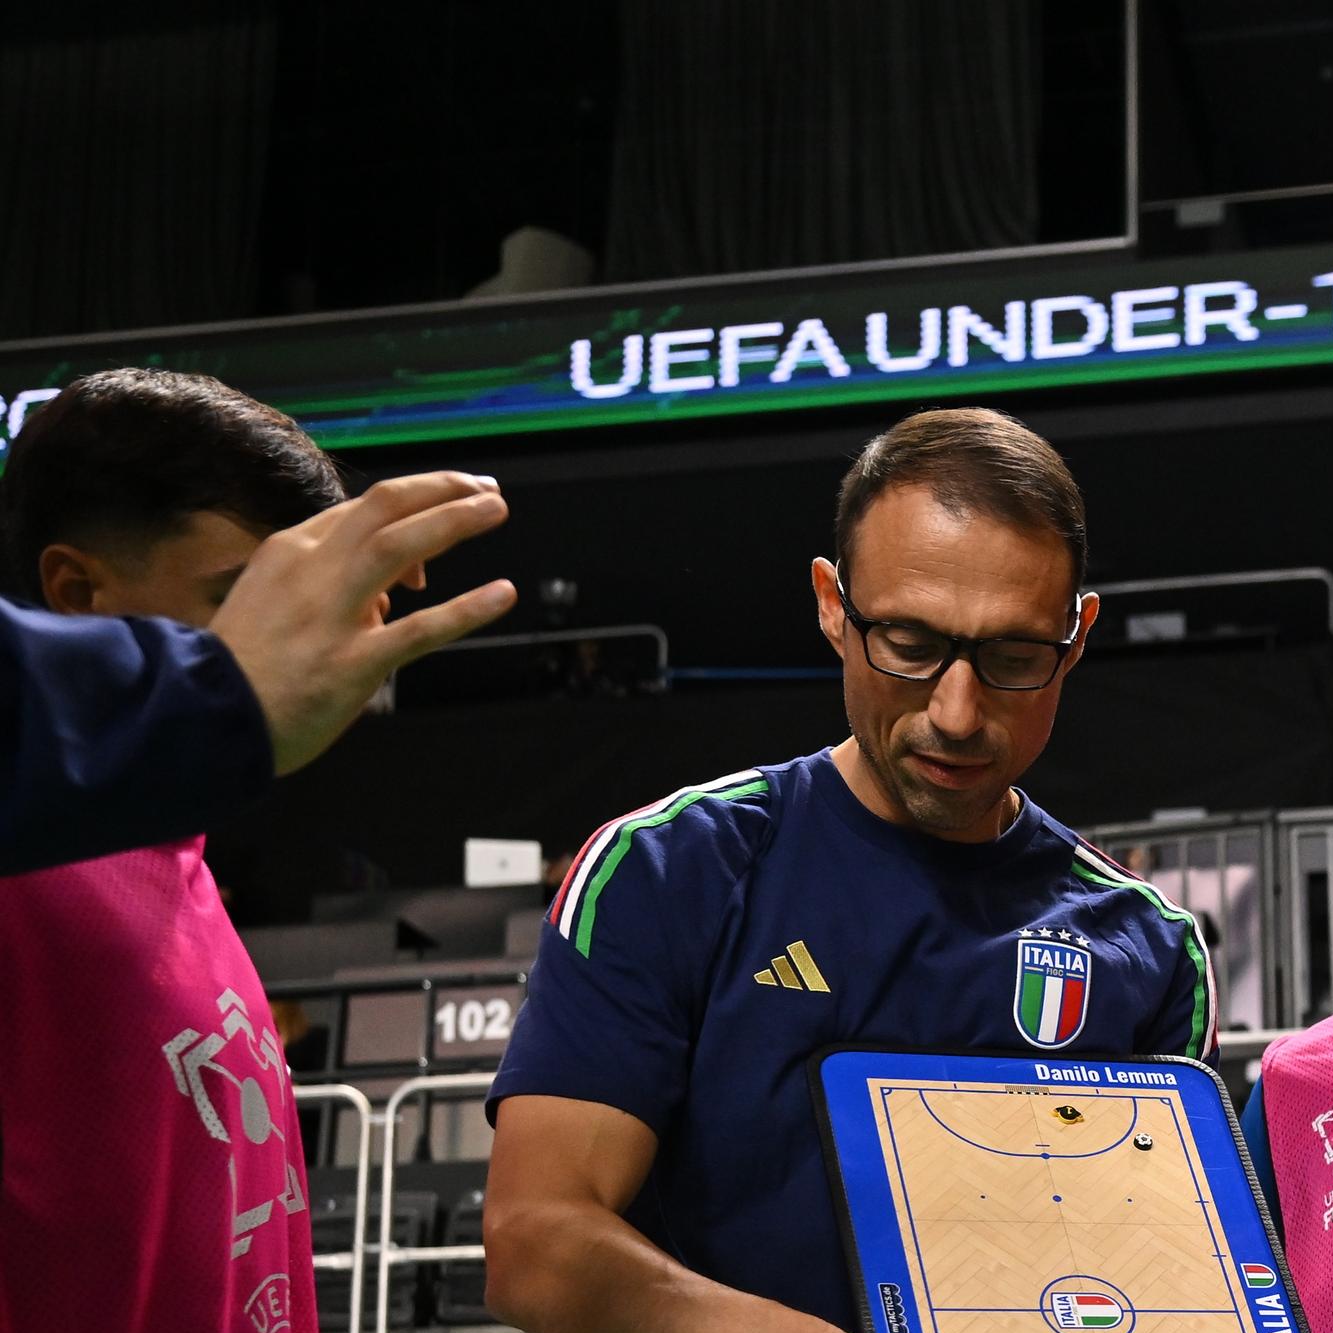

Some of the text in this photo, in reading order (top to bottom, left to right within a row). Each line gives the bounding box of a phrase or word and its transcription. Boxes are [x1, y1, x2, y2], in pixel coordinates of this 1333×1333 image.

[570, 318, 851, 400] UEFA
[1024, 946, 1085, 973] ITALIA
[1046, 967, 1064, 977] FIGC
[435, 997, 511, 1043] 102
[1034, 1063, 1178, 1086] Danilo Lemma
[1056, 1295, 1076, 1326] ITALIA
